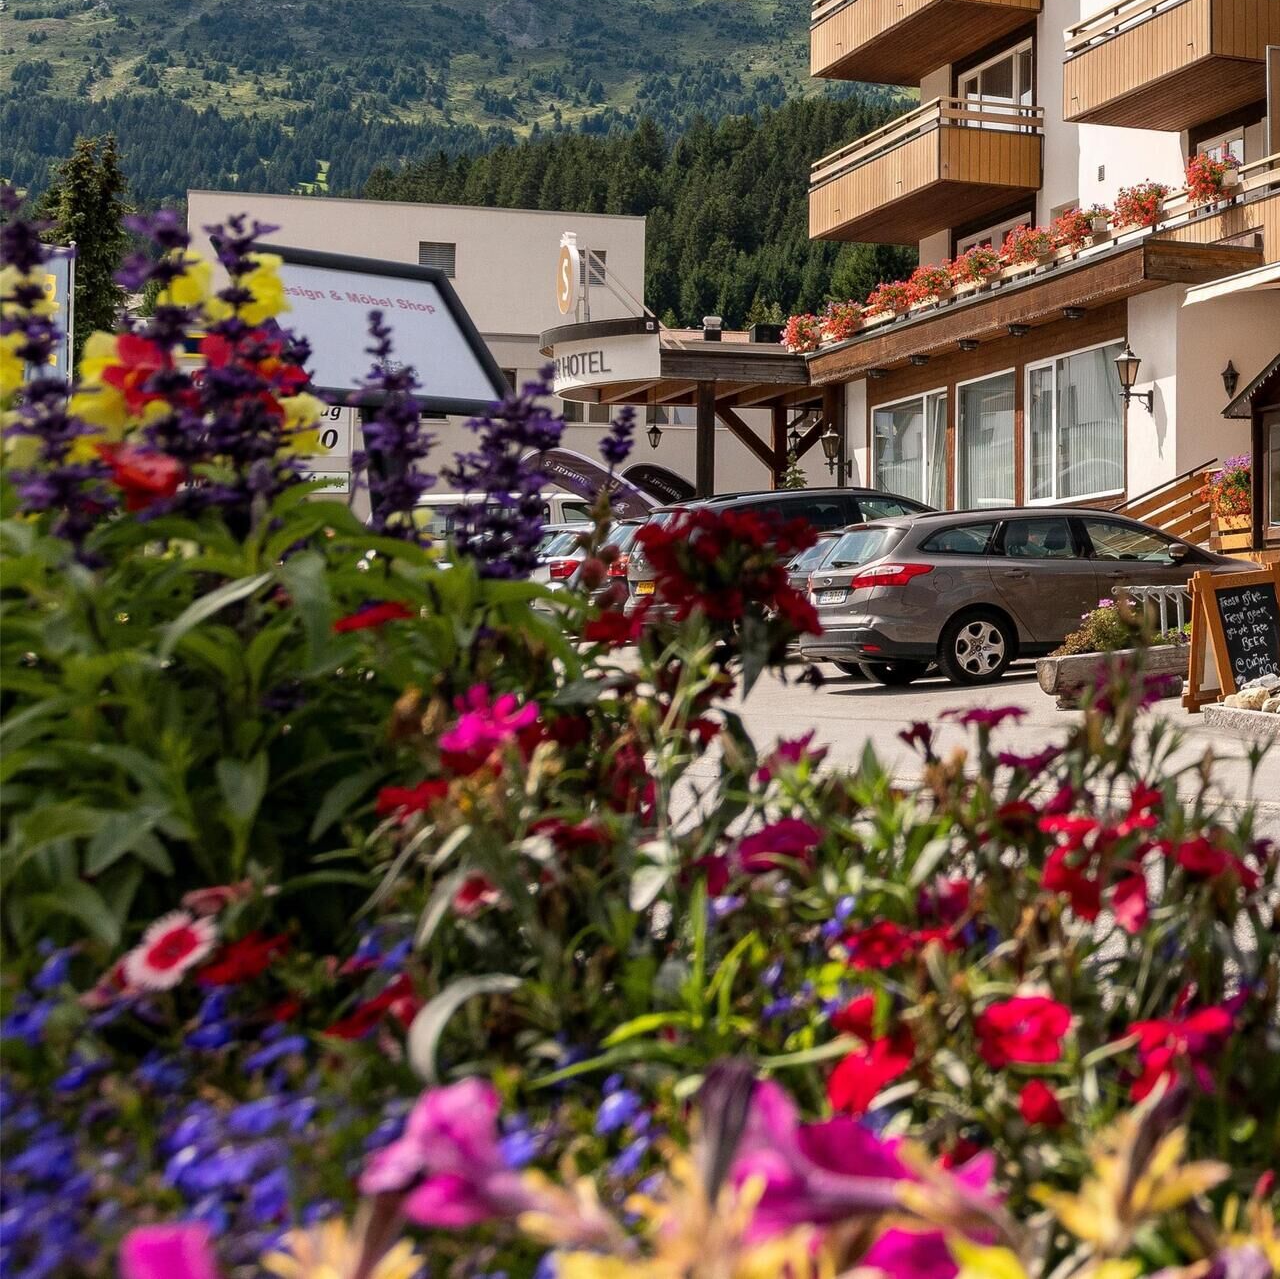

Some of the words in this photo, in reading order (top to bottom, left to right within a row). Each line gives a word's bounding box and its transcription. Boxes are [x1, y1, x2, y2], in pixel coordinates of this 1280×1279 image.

[284, 285, 325, 300] esign
[346, 291, 394, 308] Möbel
[396, 298, 436, 314] Shop
[562, 350, 612, 376] HOTEL
[1242, 636, 1268, 651] BEER
